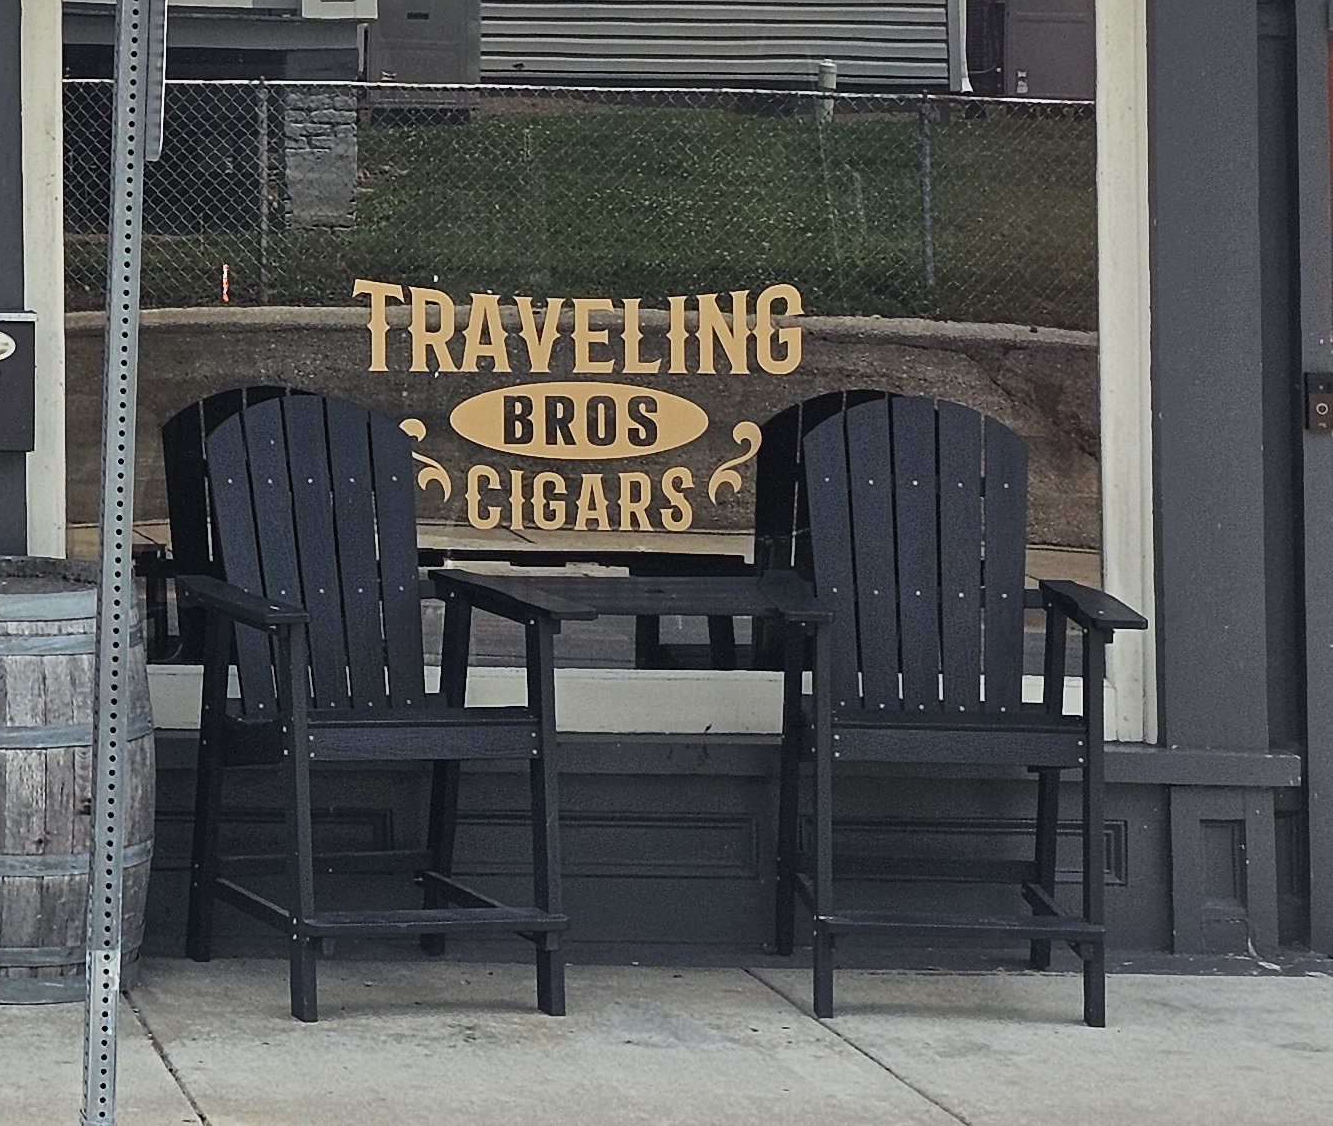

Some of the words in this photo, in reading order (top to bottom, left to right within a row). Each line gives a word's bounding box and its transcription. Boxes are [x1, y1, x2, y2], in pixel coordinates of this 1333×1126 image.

[352, 278, 805, 375] TRAVELING
[503, 395, 659, 447] BROS
[465, 464, 694, 532] CIGARS
